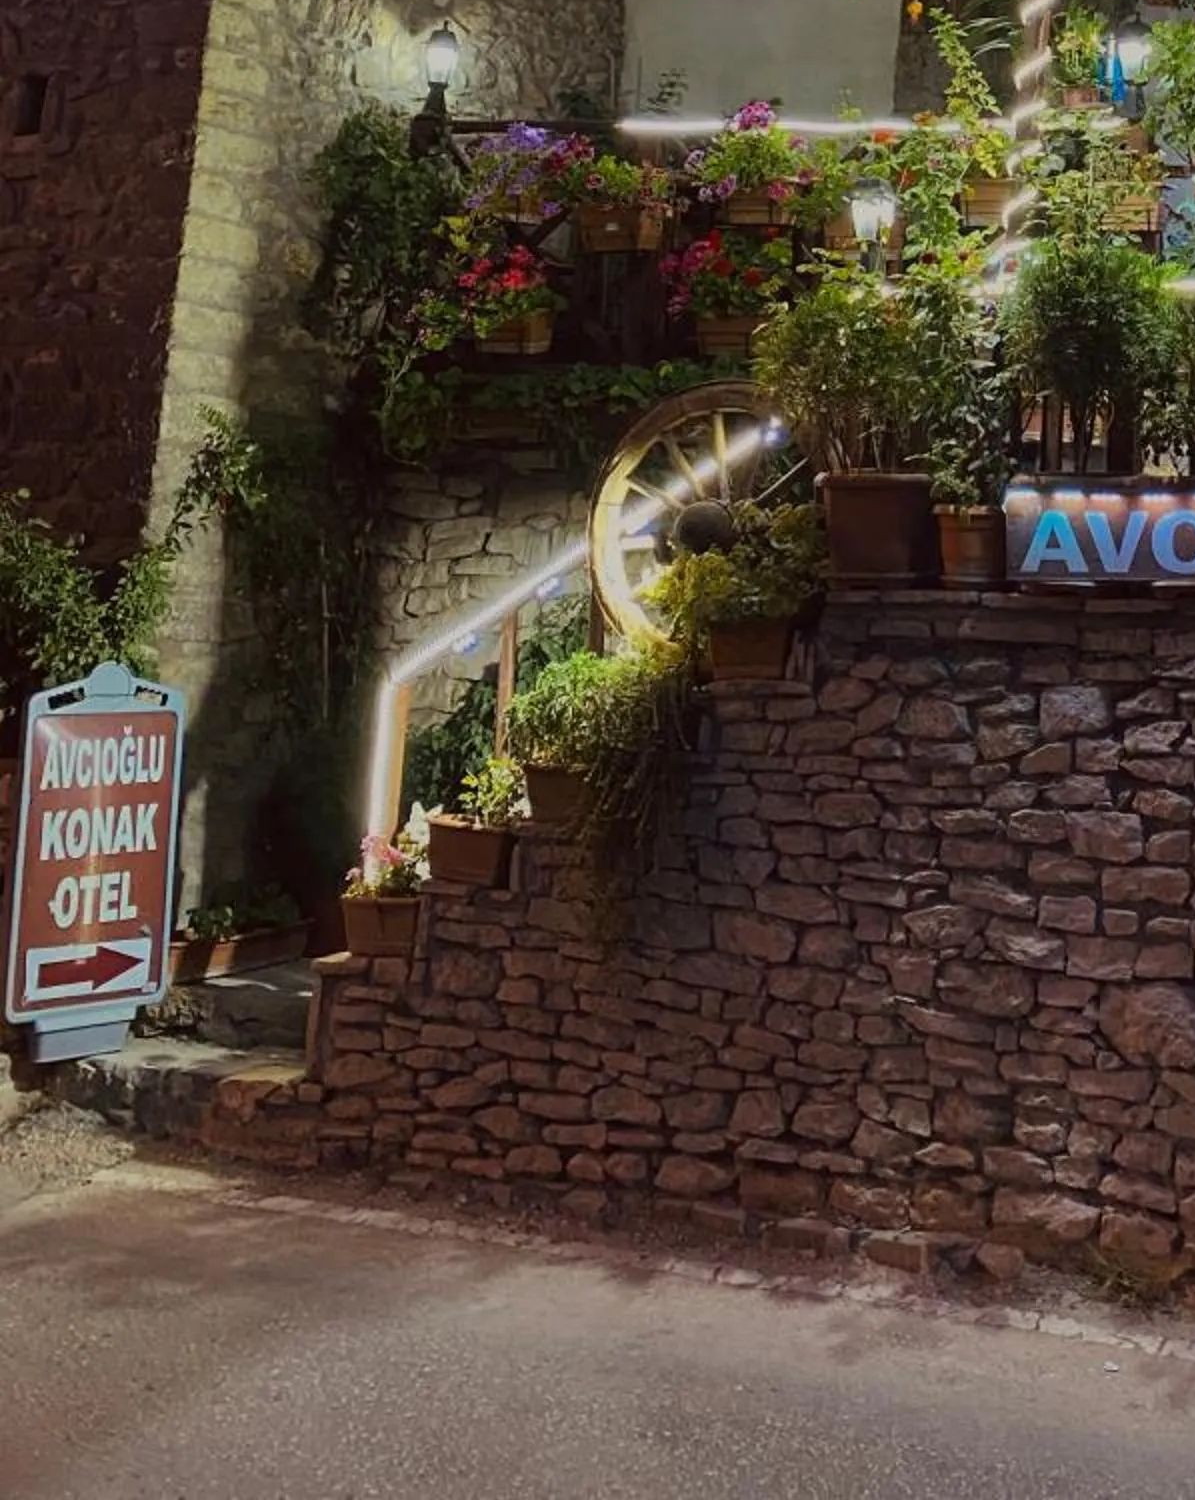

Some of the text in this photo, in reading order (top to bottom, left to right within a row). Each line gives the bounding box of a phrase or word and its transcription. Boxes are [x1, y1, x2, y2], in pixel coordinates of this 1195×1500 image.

[40, 724, 166, 791] AVCIOĞLU
[40, 803, 159, 861] KONAK
[51, 871, 138, 929] OTEL
